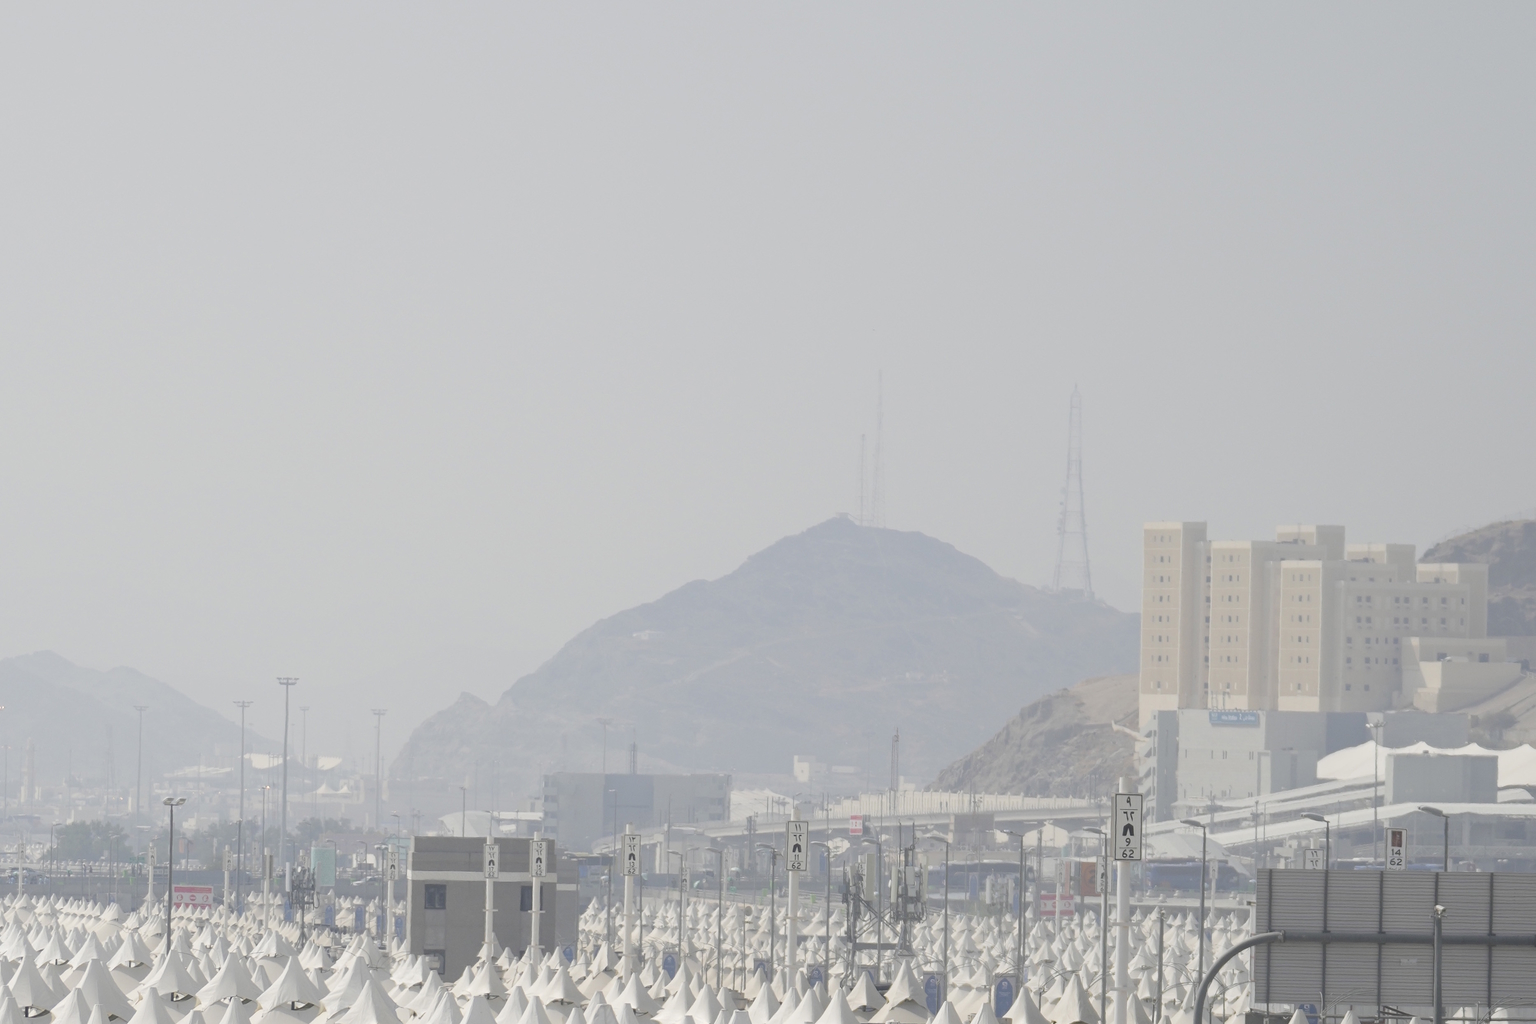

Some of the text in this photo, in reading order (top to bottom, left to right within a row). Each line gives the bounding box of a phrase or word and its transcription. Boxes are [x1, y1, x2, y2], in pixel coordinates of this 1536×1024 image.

[1123, 811, 1135, 821] ٦٢
[793, 834, 802, 842] ٦٢
[1125, 837, 1131, 846] 9
[1122, 849, 1134, 858] 62
[1389, 858, 1402, 866] 62
